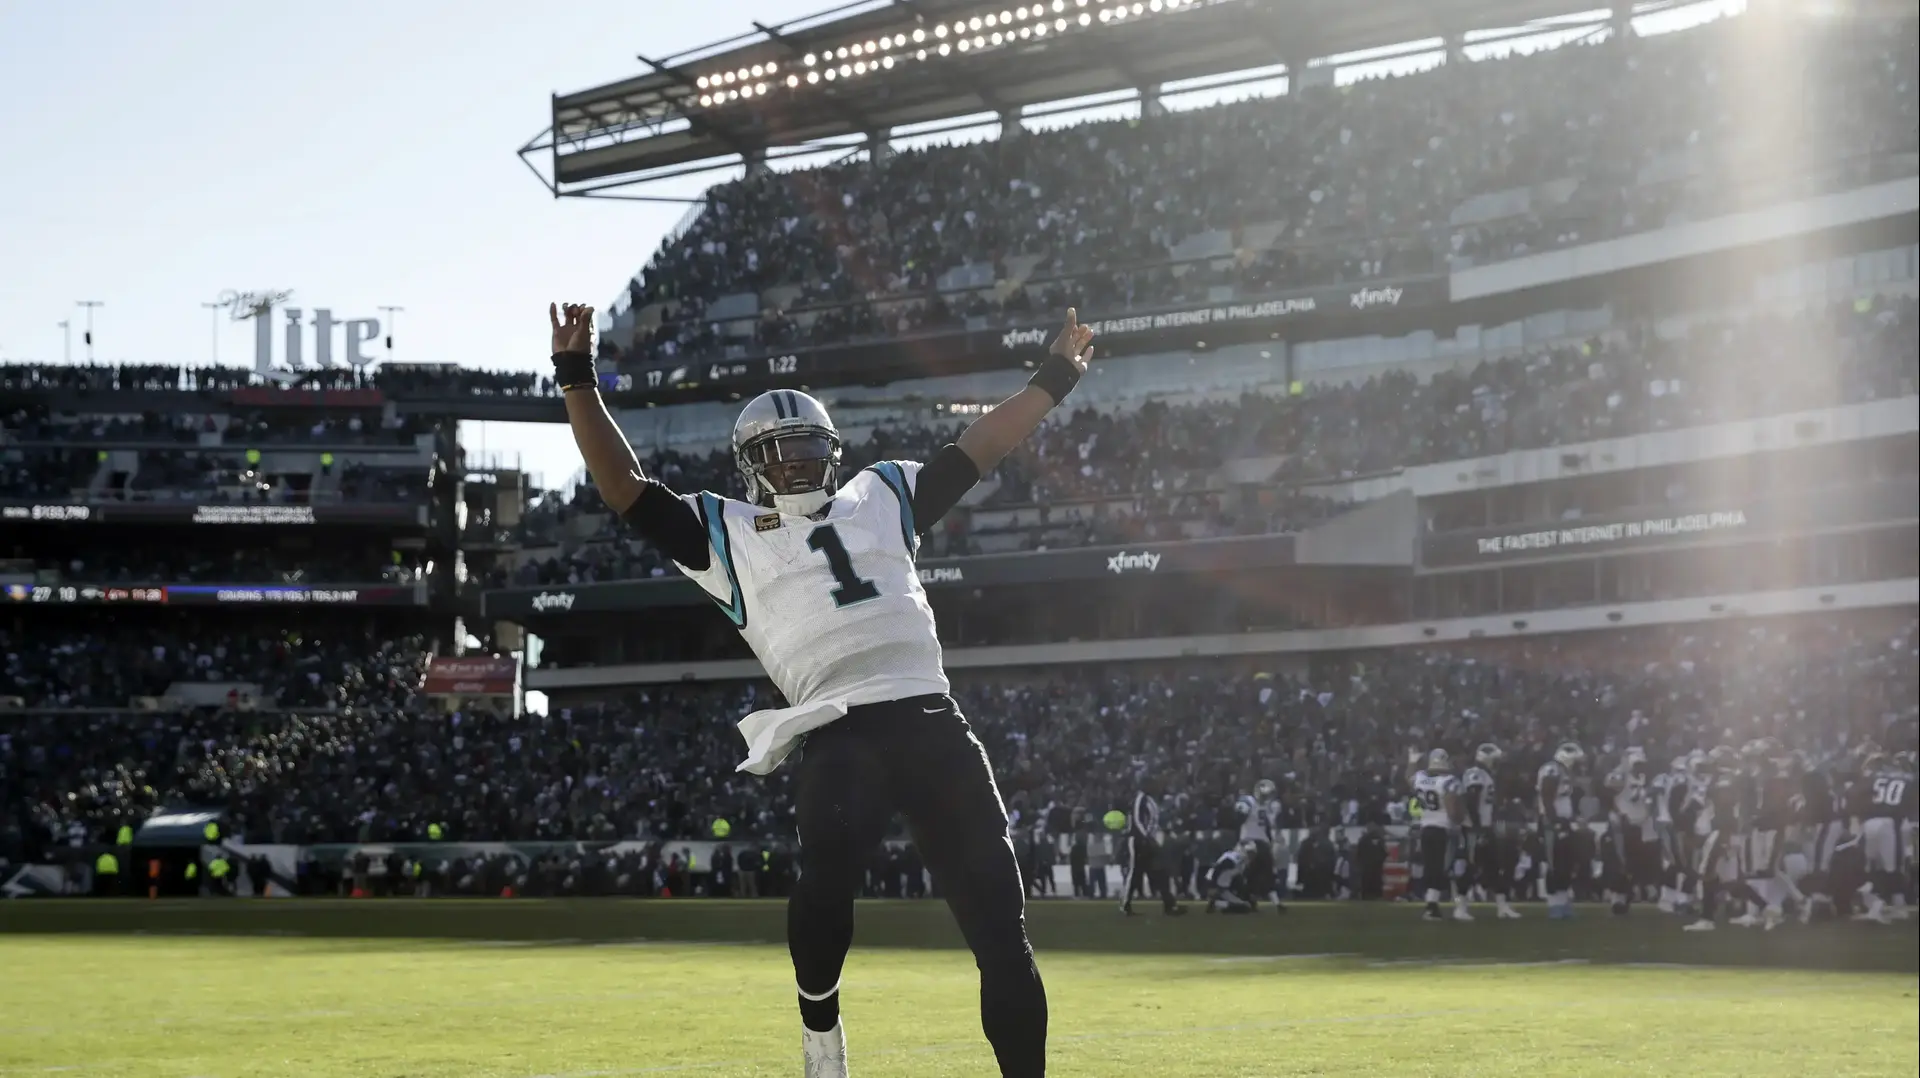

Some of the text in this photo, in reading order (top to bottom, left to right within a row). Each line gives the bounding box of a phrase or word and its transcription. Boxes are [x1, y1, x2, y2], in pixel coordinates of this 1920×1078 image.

[1350, 286, 1403, 310] xfinity
[1104, 315, 1152, 335] FASTEST
[1153, 308, 1210, 328] INTERNET
[1212, 308, 1226, 322] IN
[1228, 297, 1316, 319] PHILADELPHIA
[250, 303, 380, 384] Lite
[1001, 328, 1048, 350] xfinity
[767, 355, 797, 374] 1:22
[647, 370, 663, 387] 17
[1477, 510, 1747, 554] THE FASTEST INTERNET IN PHILADELPHIA
[806, 522, 883, 609] 1
[1106, 551, 1161, 574] xfinity
[32, 585, 77, 602] 27 10
[531, 591, 575, 612] xfinity
[1872, 778, 1906, 806] 50
